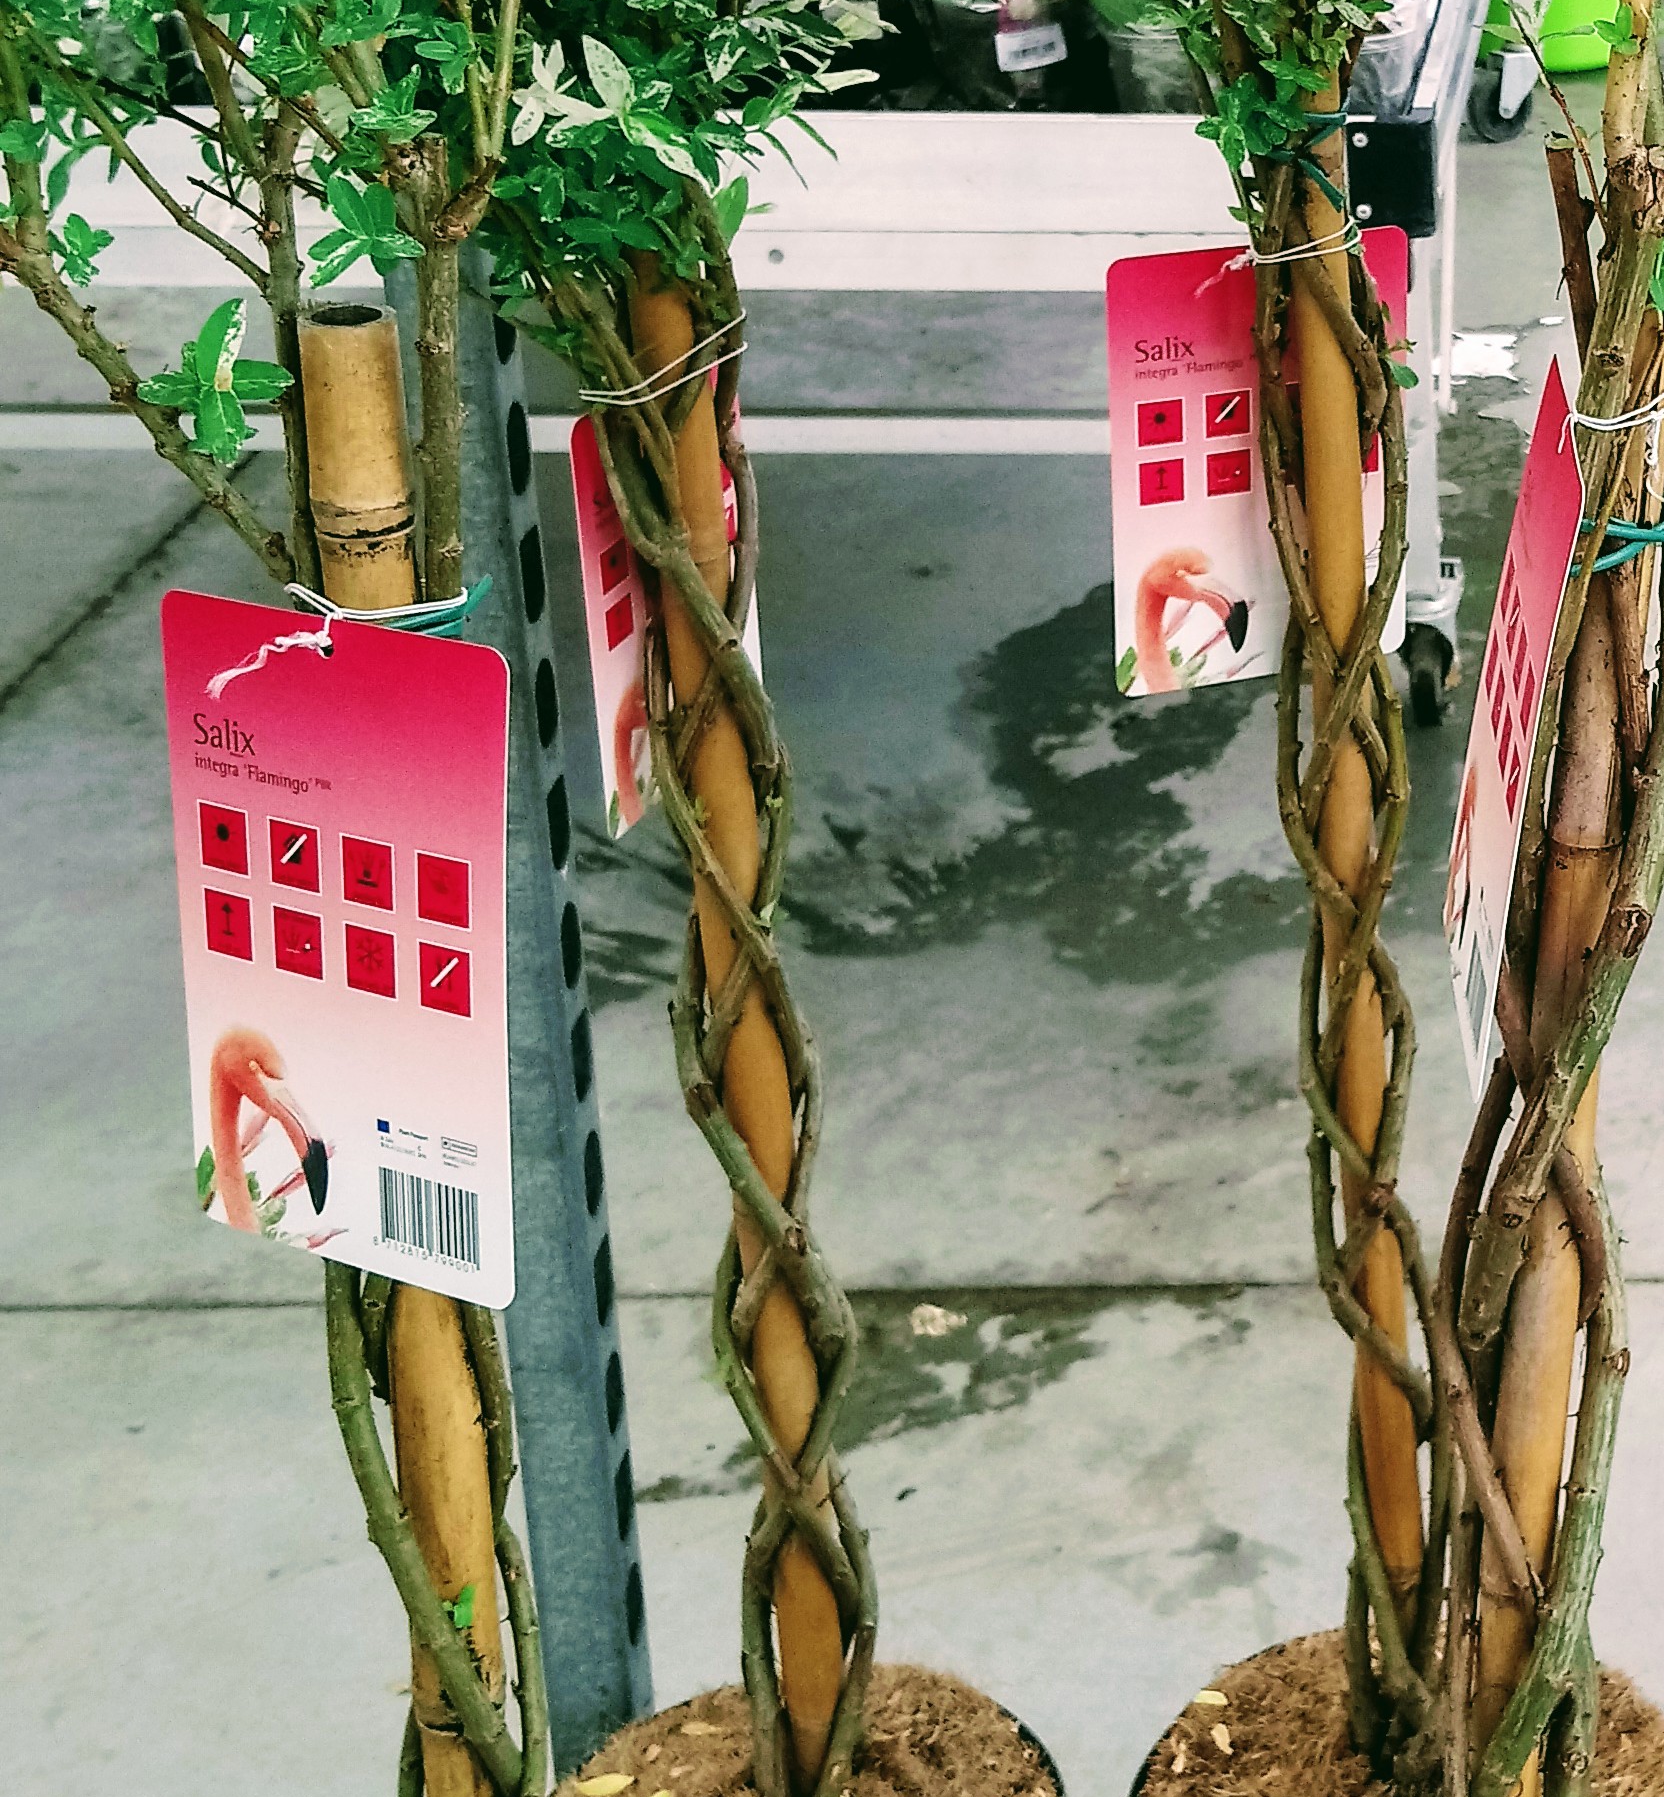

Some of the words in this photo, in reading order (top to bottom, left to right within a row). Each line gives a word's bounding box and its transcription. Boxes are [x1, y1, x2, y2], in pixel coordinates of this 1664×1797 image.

[1134, 336, 1195, 363] Salix
[193, 712, 256, 758] Salix
[194, 751, 239, 778] integra
